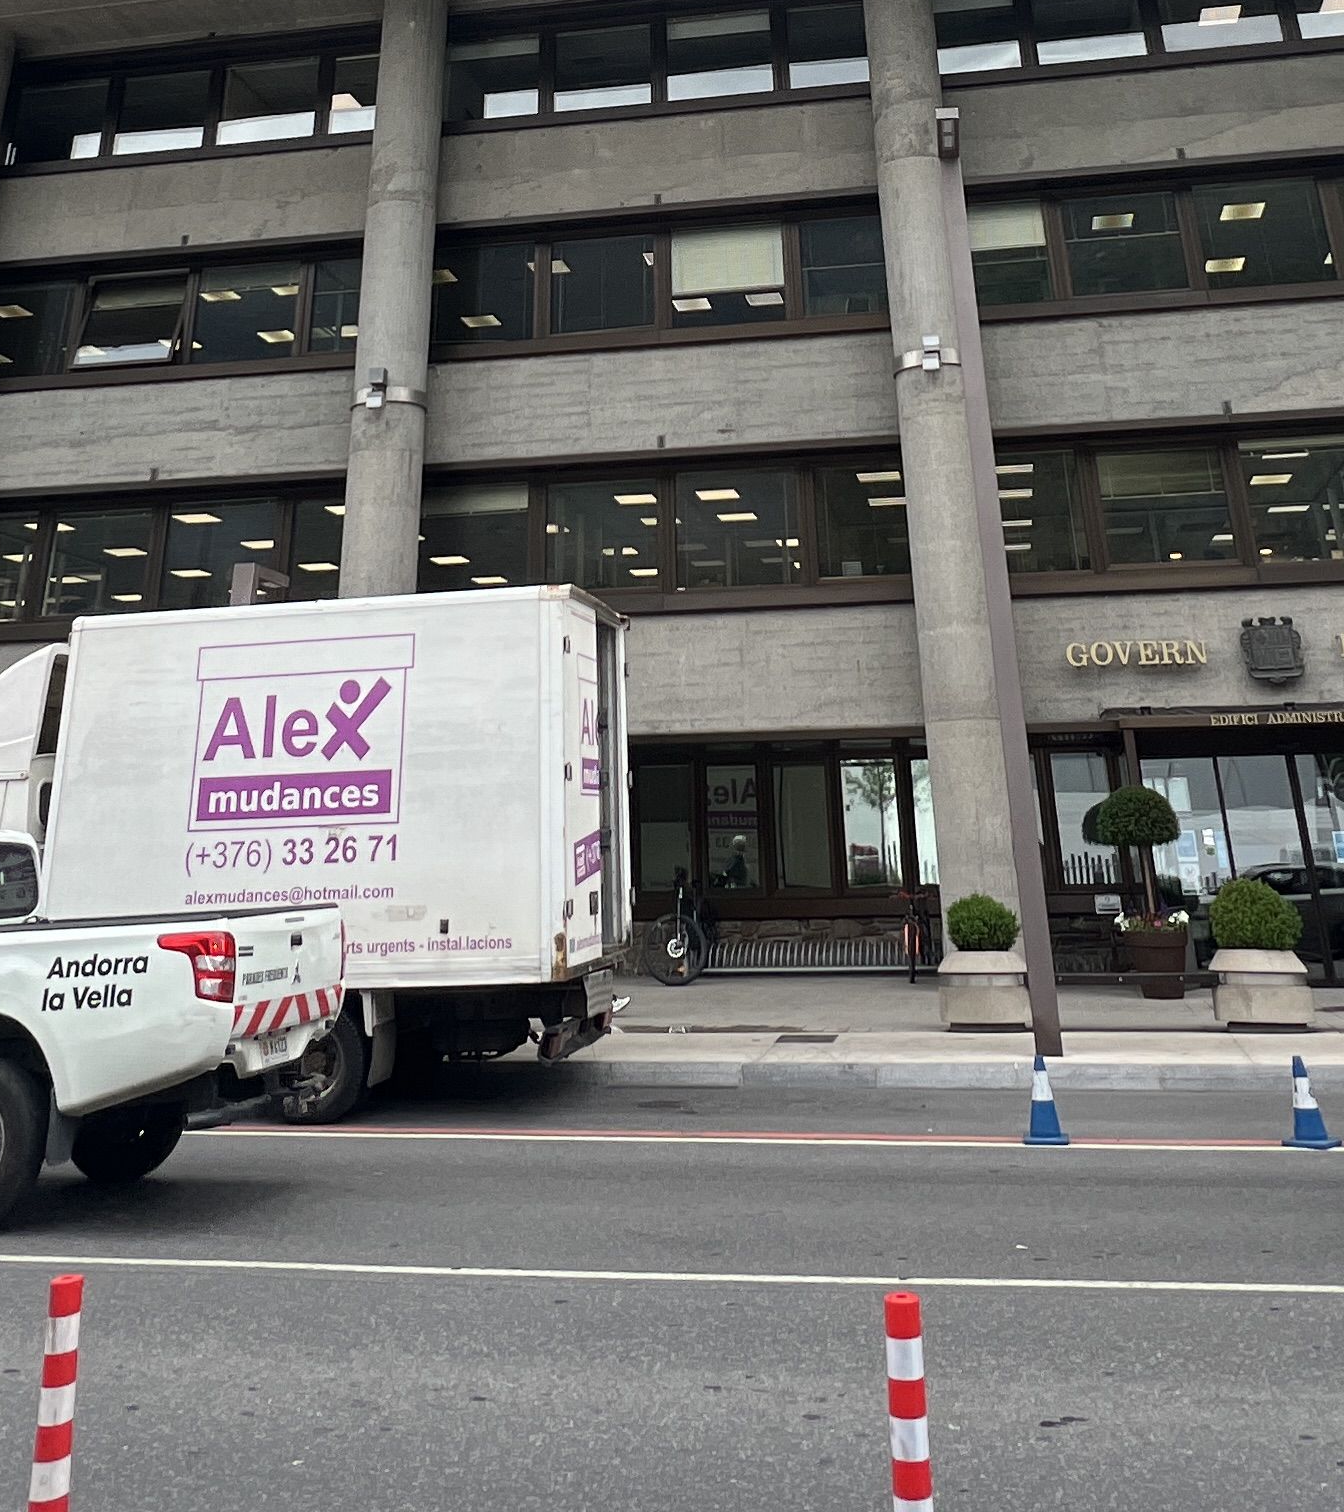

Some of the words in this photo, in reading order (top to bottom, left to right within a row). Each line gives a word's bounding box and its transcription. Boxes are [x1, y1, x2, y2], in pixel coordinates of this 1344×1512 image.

[1065, 639, 1208, 668] GOVERN
[202, 676, 392, 761] Alex
[581, 697, 598, 746] Al
[1209, 712, 1259, 726] EDIFICI
[208, 781, 380, 813] mudances
[185, 839, 272, 877] (+376)
[282, 838, 314, 866] 33
[324, 835, 357, 864] 26
[368, 834, 398, 862] 71
[184, 884, 394, 905] alexmudances@hotmail.com
[367, 938, 416, 956] urgents
[46, 953, 149, 979] Andorra
[41, 988, 65, 1011] la
[72, 984, 133, 1009] Vella
